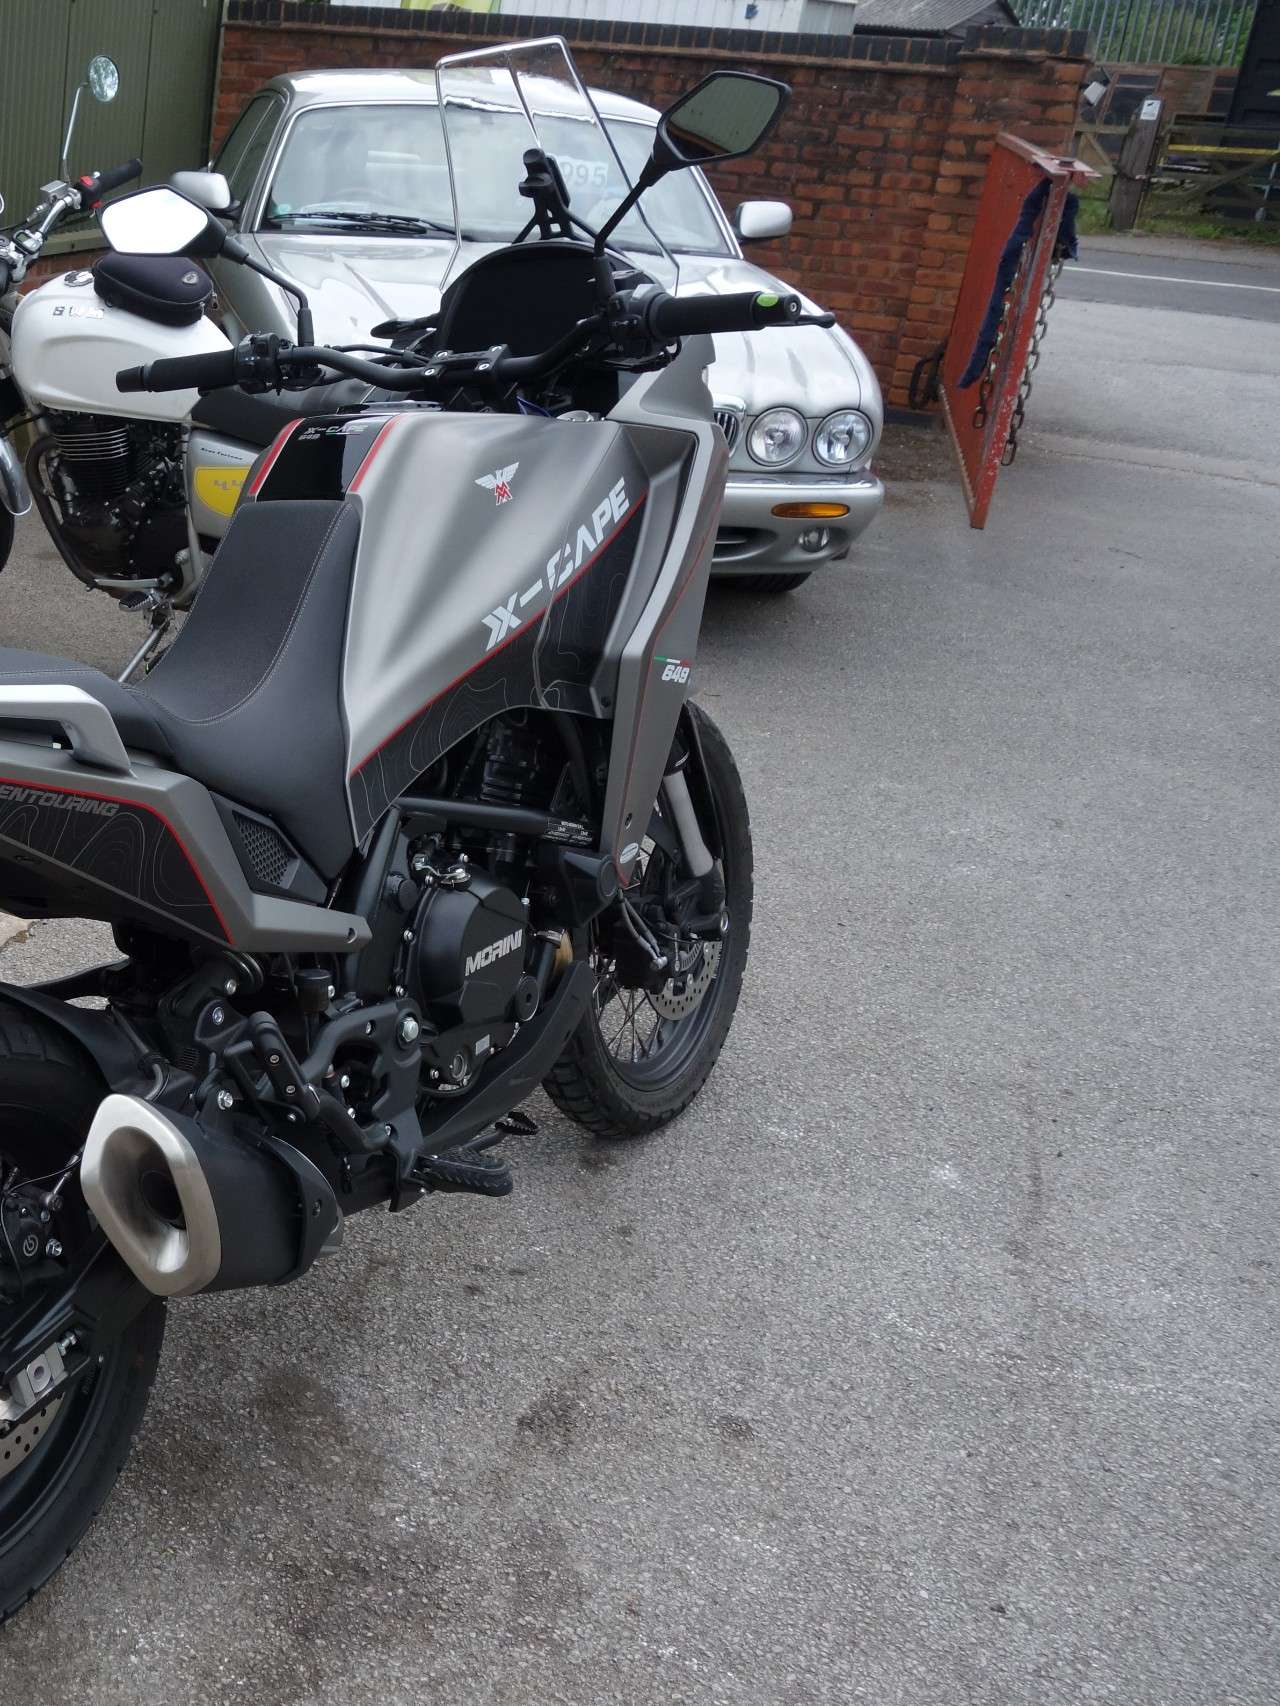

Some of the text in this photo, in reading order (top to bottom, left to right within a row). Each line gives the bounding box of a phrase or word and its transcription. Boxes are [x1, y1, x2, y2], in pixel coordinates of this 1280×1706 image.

[481, 476, 630, 651] X-CAPE
[661, 664, 690, 684] 649
[464, 928, 523, 977] MORINI
